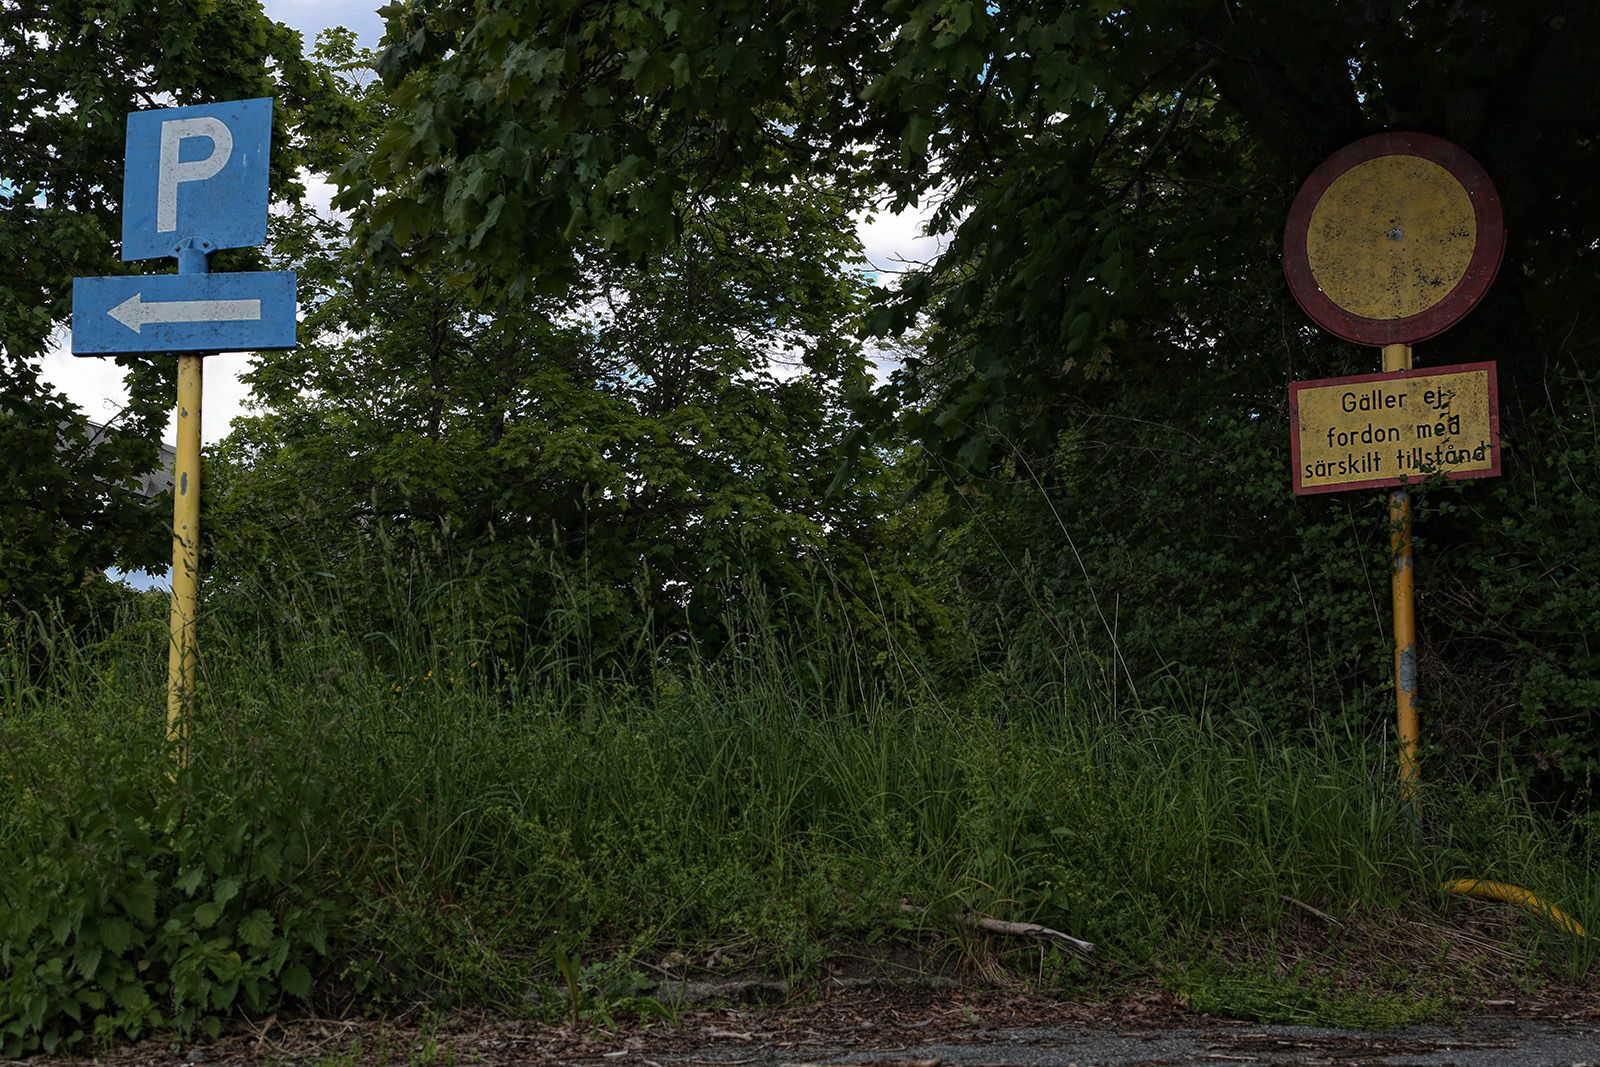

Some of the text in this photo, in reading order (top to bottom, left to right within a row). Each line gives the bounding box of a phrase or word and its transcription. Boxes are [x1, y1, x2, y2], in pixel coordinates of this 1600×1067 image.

[157, 116, 233, 233] P
[1342, 386, 1443, 413] Gäller ej
[1327, 414, 1461, 448] fordon med
[1305, 440, 1486, 479] särskilt tillstånd
